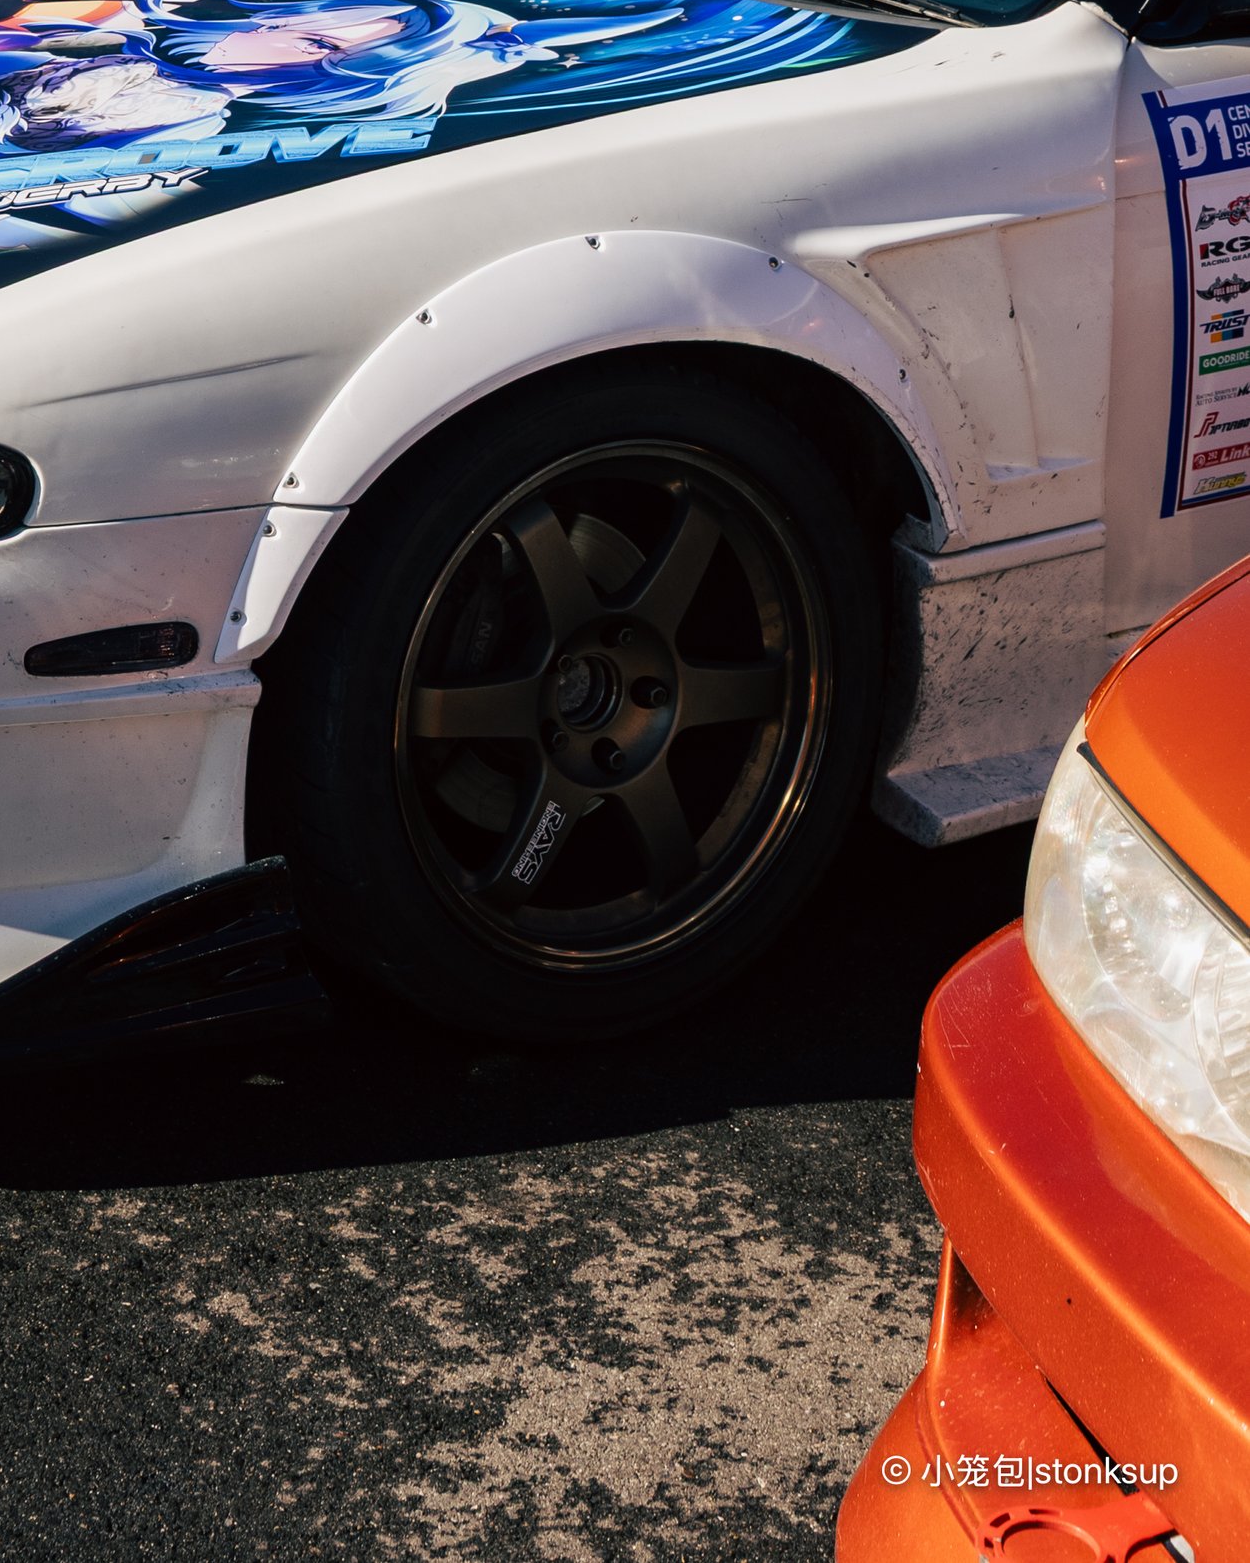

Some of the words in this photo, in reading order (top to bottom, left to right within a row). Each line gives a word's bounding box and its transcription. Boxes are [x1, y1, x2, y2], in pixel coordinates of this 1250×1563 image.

[1167, 108, 1233, 171] D1
[1199, 235, 1250, 261] RG
[1201, 257, 1230, 268] RACING
[1199, 314, 1250, 335] TRUST
[1202, 350, 1250, 369] GOODRIDE
[1220, 443, 1250, 462] Link
[511, 800, 555, 878] ENGINEERING
[517, 802, 567, 885] RAYS
